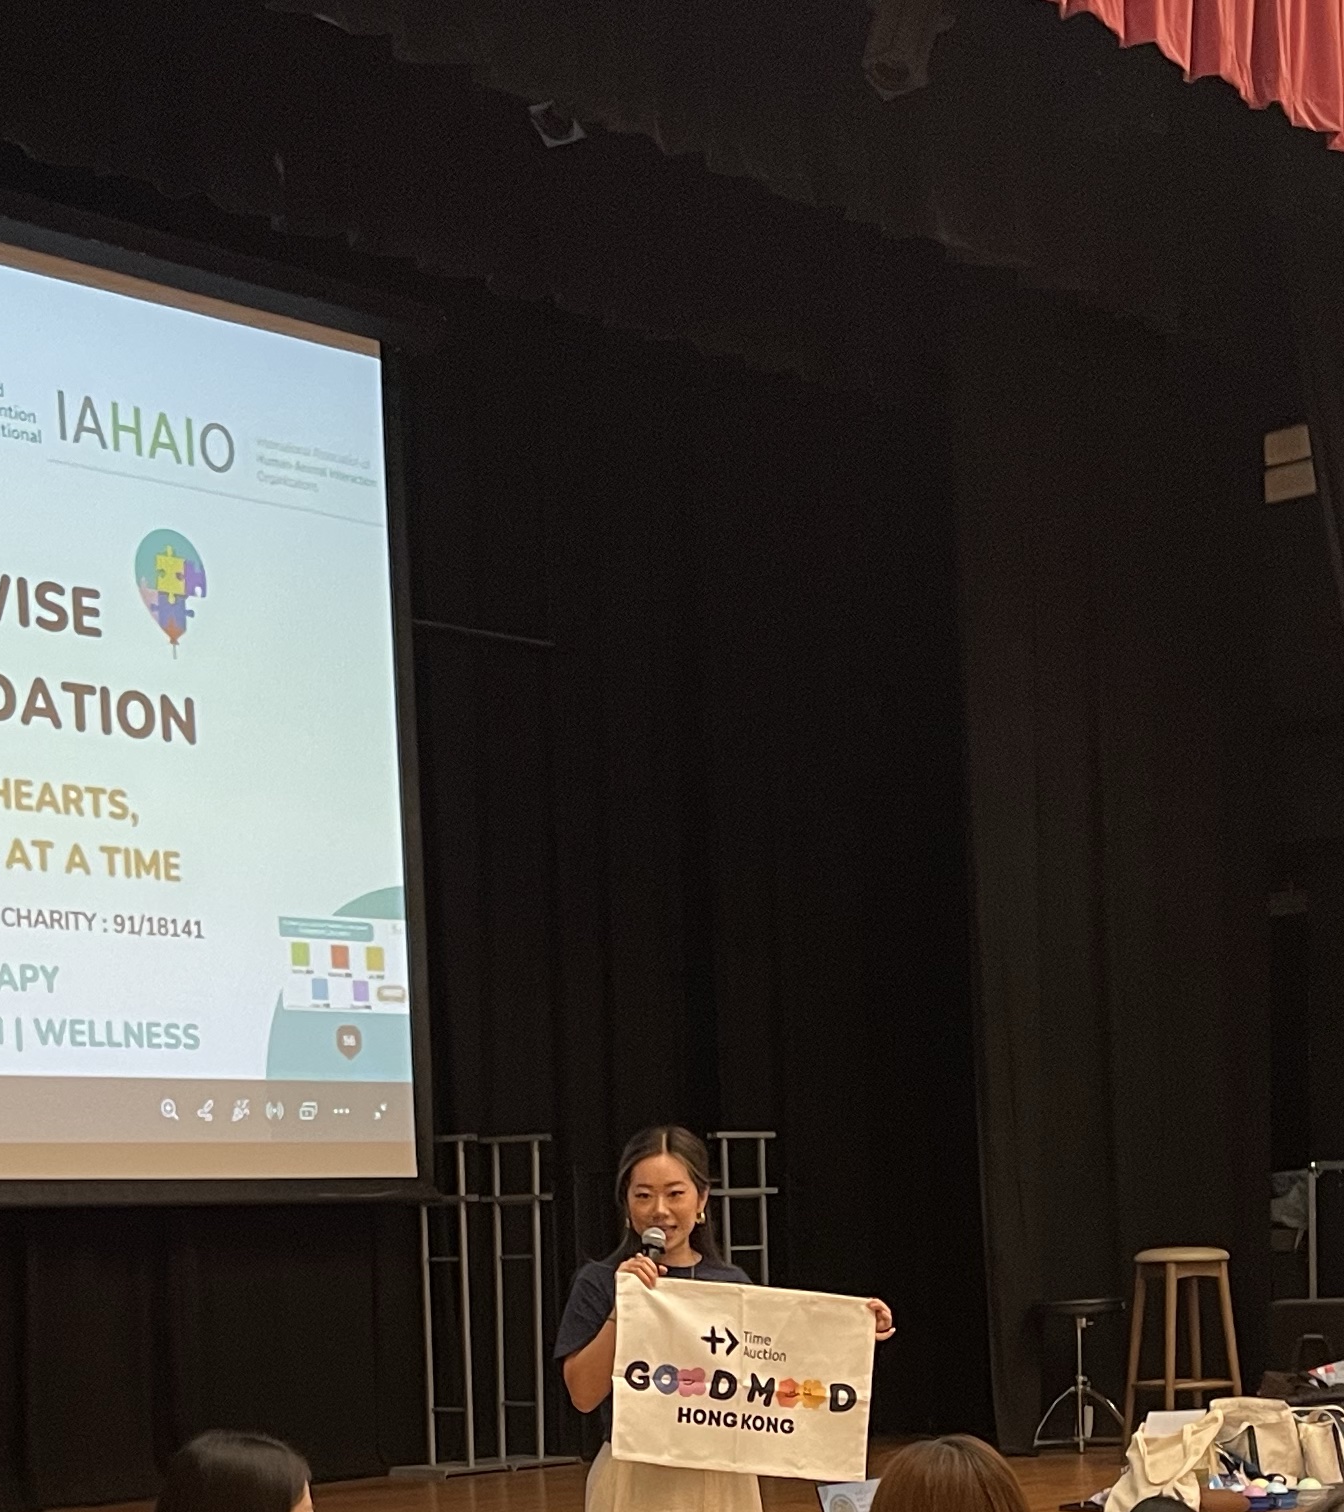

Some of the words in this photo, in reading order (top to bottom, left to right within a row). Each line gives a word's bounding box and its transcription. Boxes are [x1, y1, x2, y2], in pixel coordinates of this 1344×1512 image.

[56, 390, 235, 473] IAHAIO
[6, 837, 54, 872] AT
[65, 843, 91, 876] A
[99, 845, 181, 882] TIME
[1, 907, 97, 932] CHARITY
[113, 914, 205, 940] 91/18141
[33, 1018, 201, 1050] WELLNESS
[743, 1346, 787, 1362] Auction
[744, 1331, 772, 1346] Time
[677, 1407, 737, 1429] HONG
[741, 1414, 795, 1434] KONG
